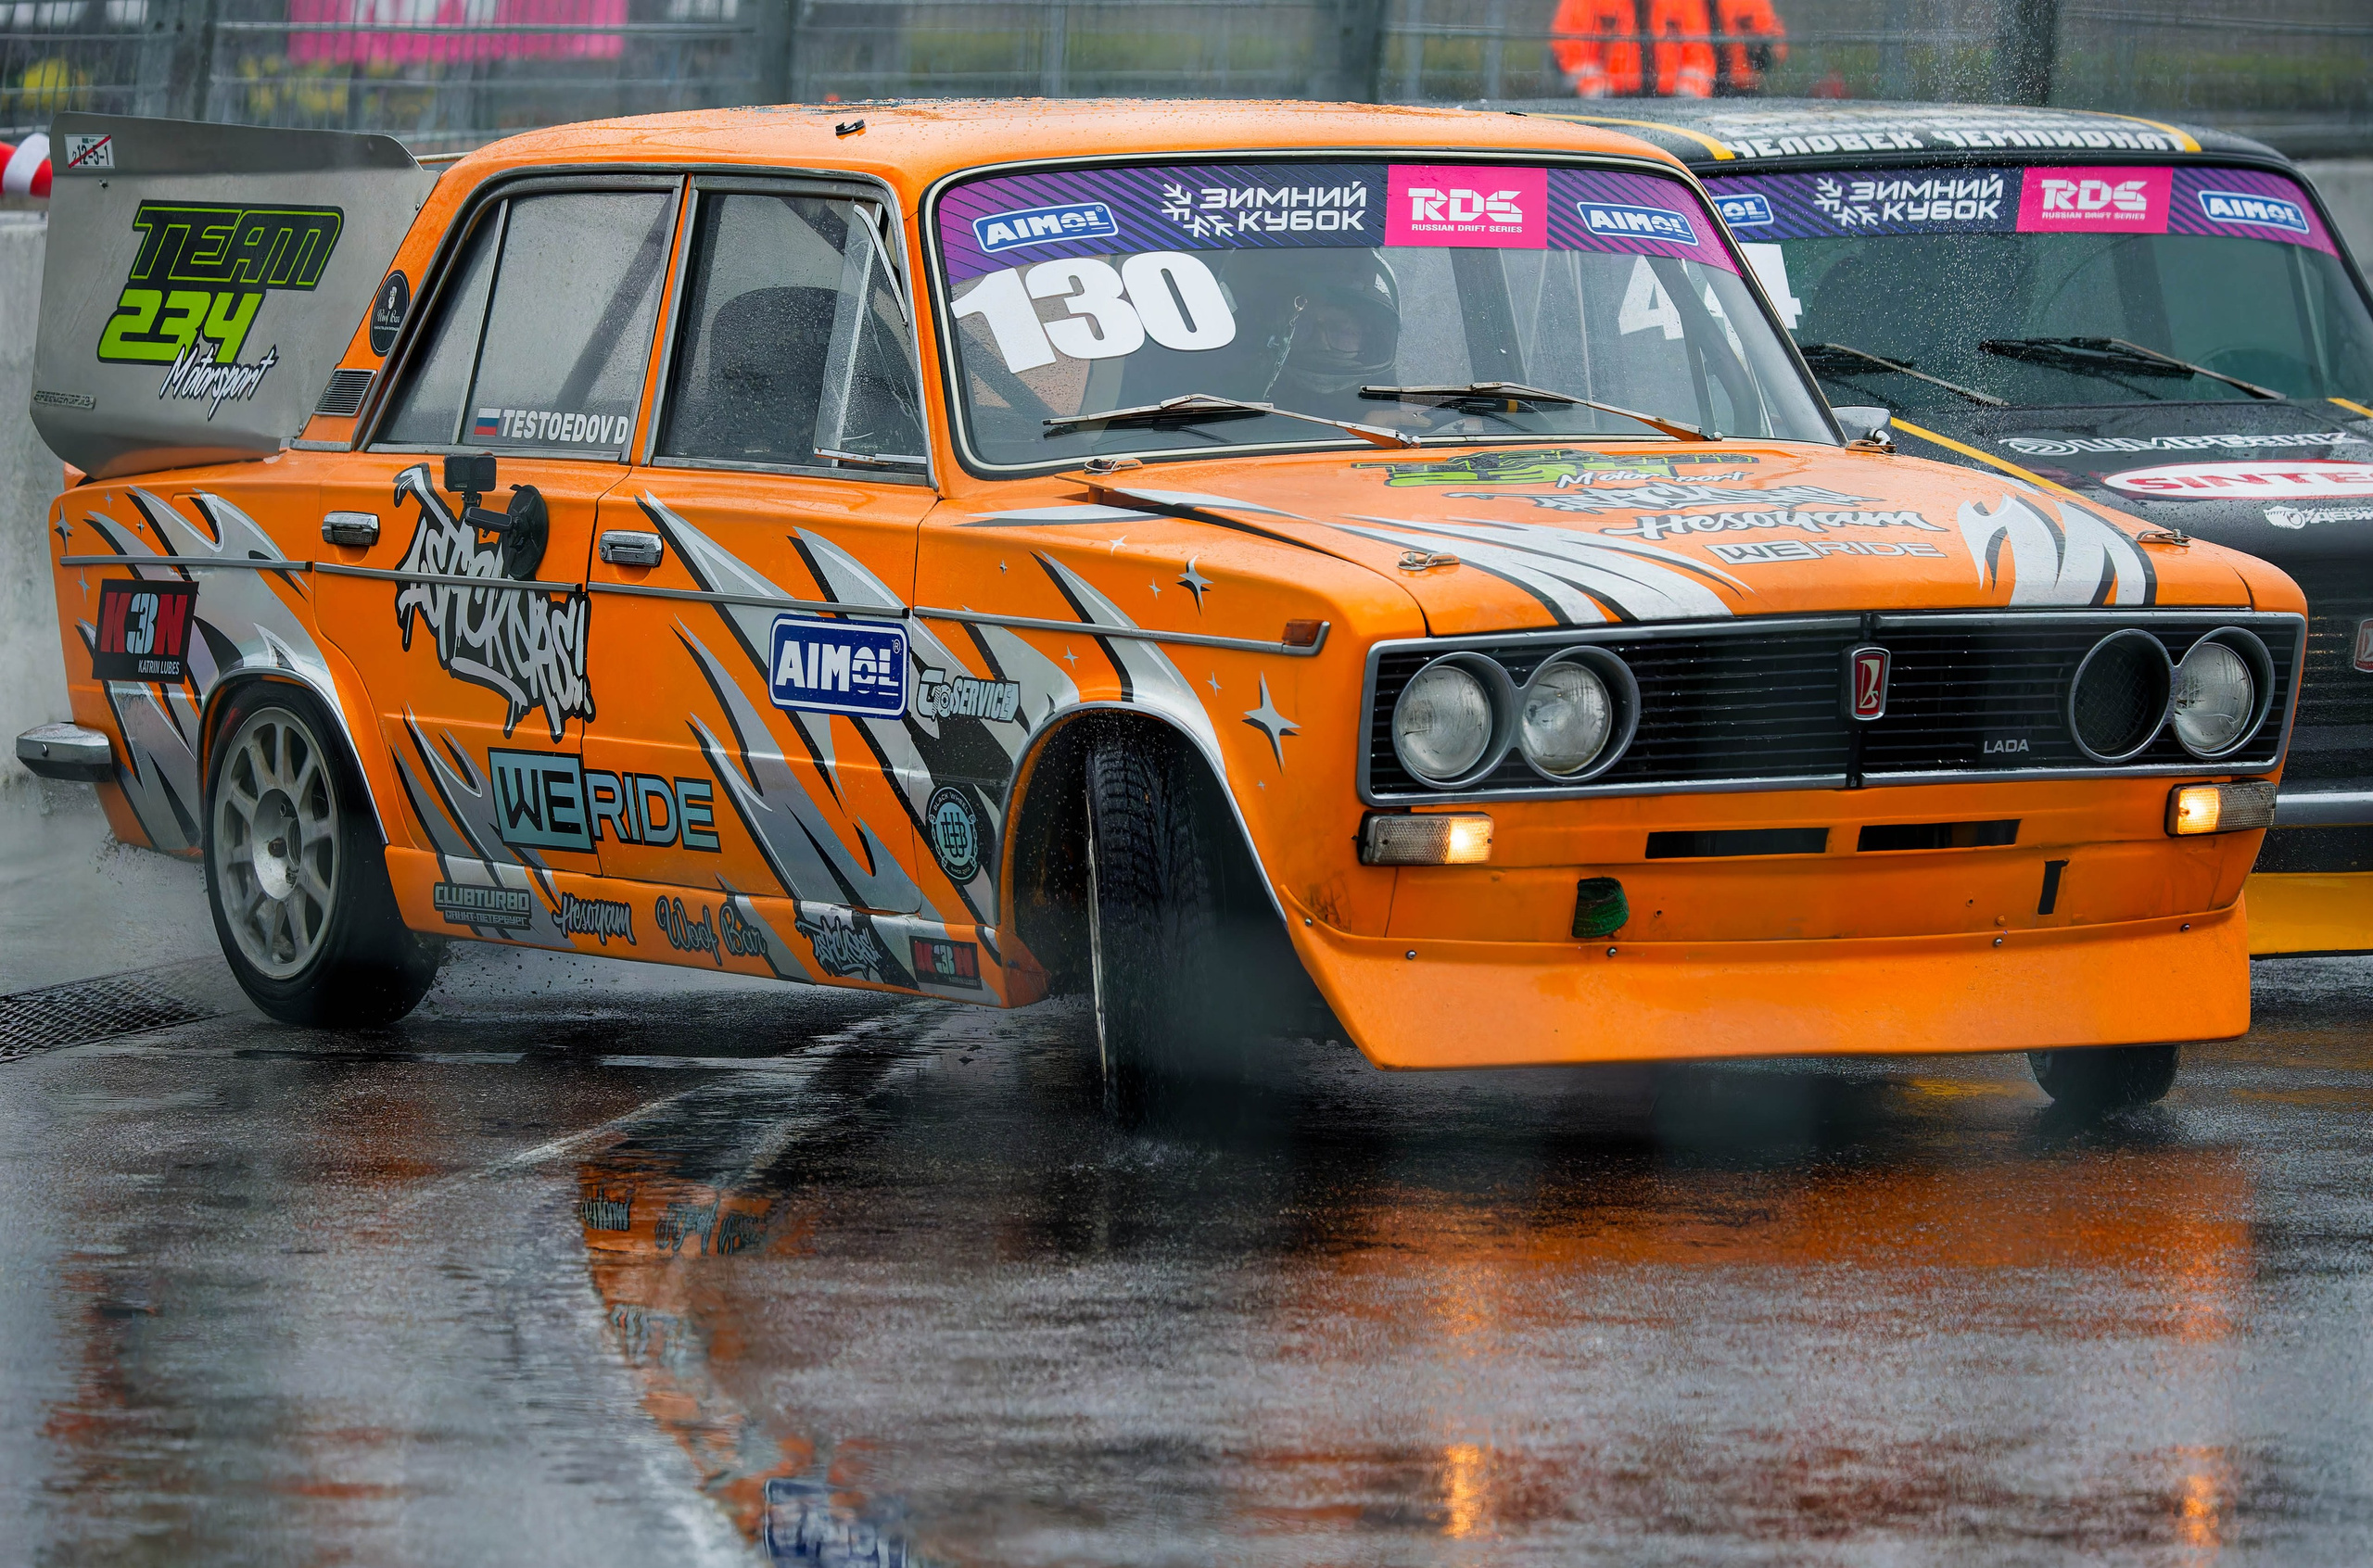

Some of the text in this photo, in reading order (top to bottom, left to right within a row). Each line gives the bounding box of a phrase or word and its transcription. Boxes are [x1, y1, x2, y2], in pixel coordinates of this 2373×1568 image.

[1721, 130, 2186, 158] ЧЕЛОВЕК ЧЕМПИОНАТ
[1200, 181, 1367, 208] ЗИМНИЙ
[1849, 174, 2004, 201] ЗИМНИЙ
[2041, 179, 2148, 211] RDS
[1408, 187, 1523, 223] RDS
[1883, 199, 2000, 221] КУБОК
[2041, 212, 2146, 221] RUSSIAN DRIFT SERIES
[2209, 197, 2303, 224] AIMOL
[986, 210, 1111, 246] AIMOL
[1237, 209, 1364, 232] КУБОК
[1411, 223, 1455, 232] RUSSIAN
[1589, 209, 1693, 239] AIMOL
[130, 204, 342, 286] TEAM
[98, 288, 262, 363] 234
[950, 251, 1237, 374] 130
[159, 344, 278, 420] Motorsport
[502, 409, 629, 445] TESTOEDOV D
[2126, 472, 2373, 490] SINTE
[1600, 510, 1950, 541] Hesoyam
[99, 591, 188, 656] K3N
[137, 659, 180, 675] KATRIN LUBES
[775, 639, 899, 697] AIMOL
[952, 677, 1020, 722] SERVICE
[1984, 739, 2030, 753] LADA
[933, 792, 948, 811] BLACK
[434, 885, 531, 912] CLUBTURBO
[552, 892, 637, 946] Hesoyam
[654, 894, 723, 967] Woof
[718, 901, 768, 956] Bar
